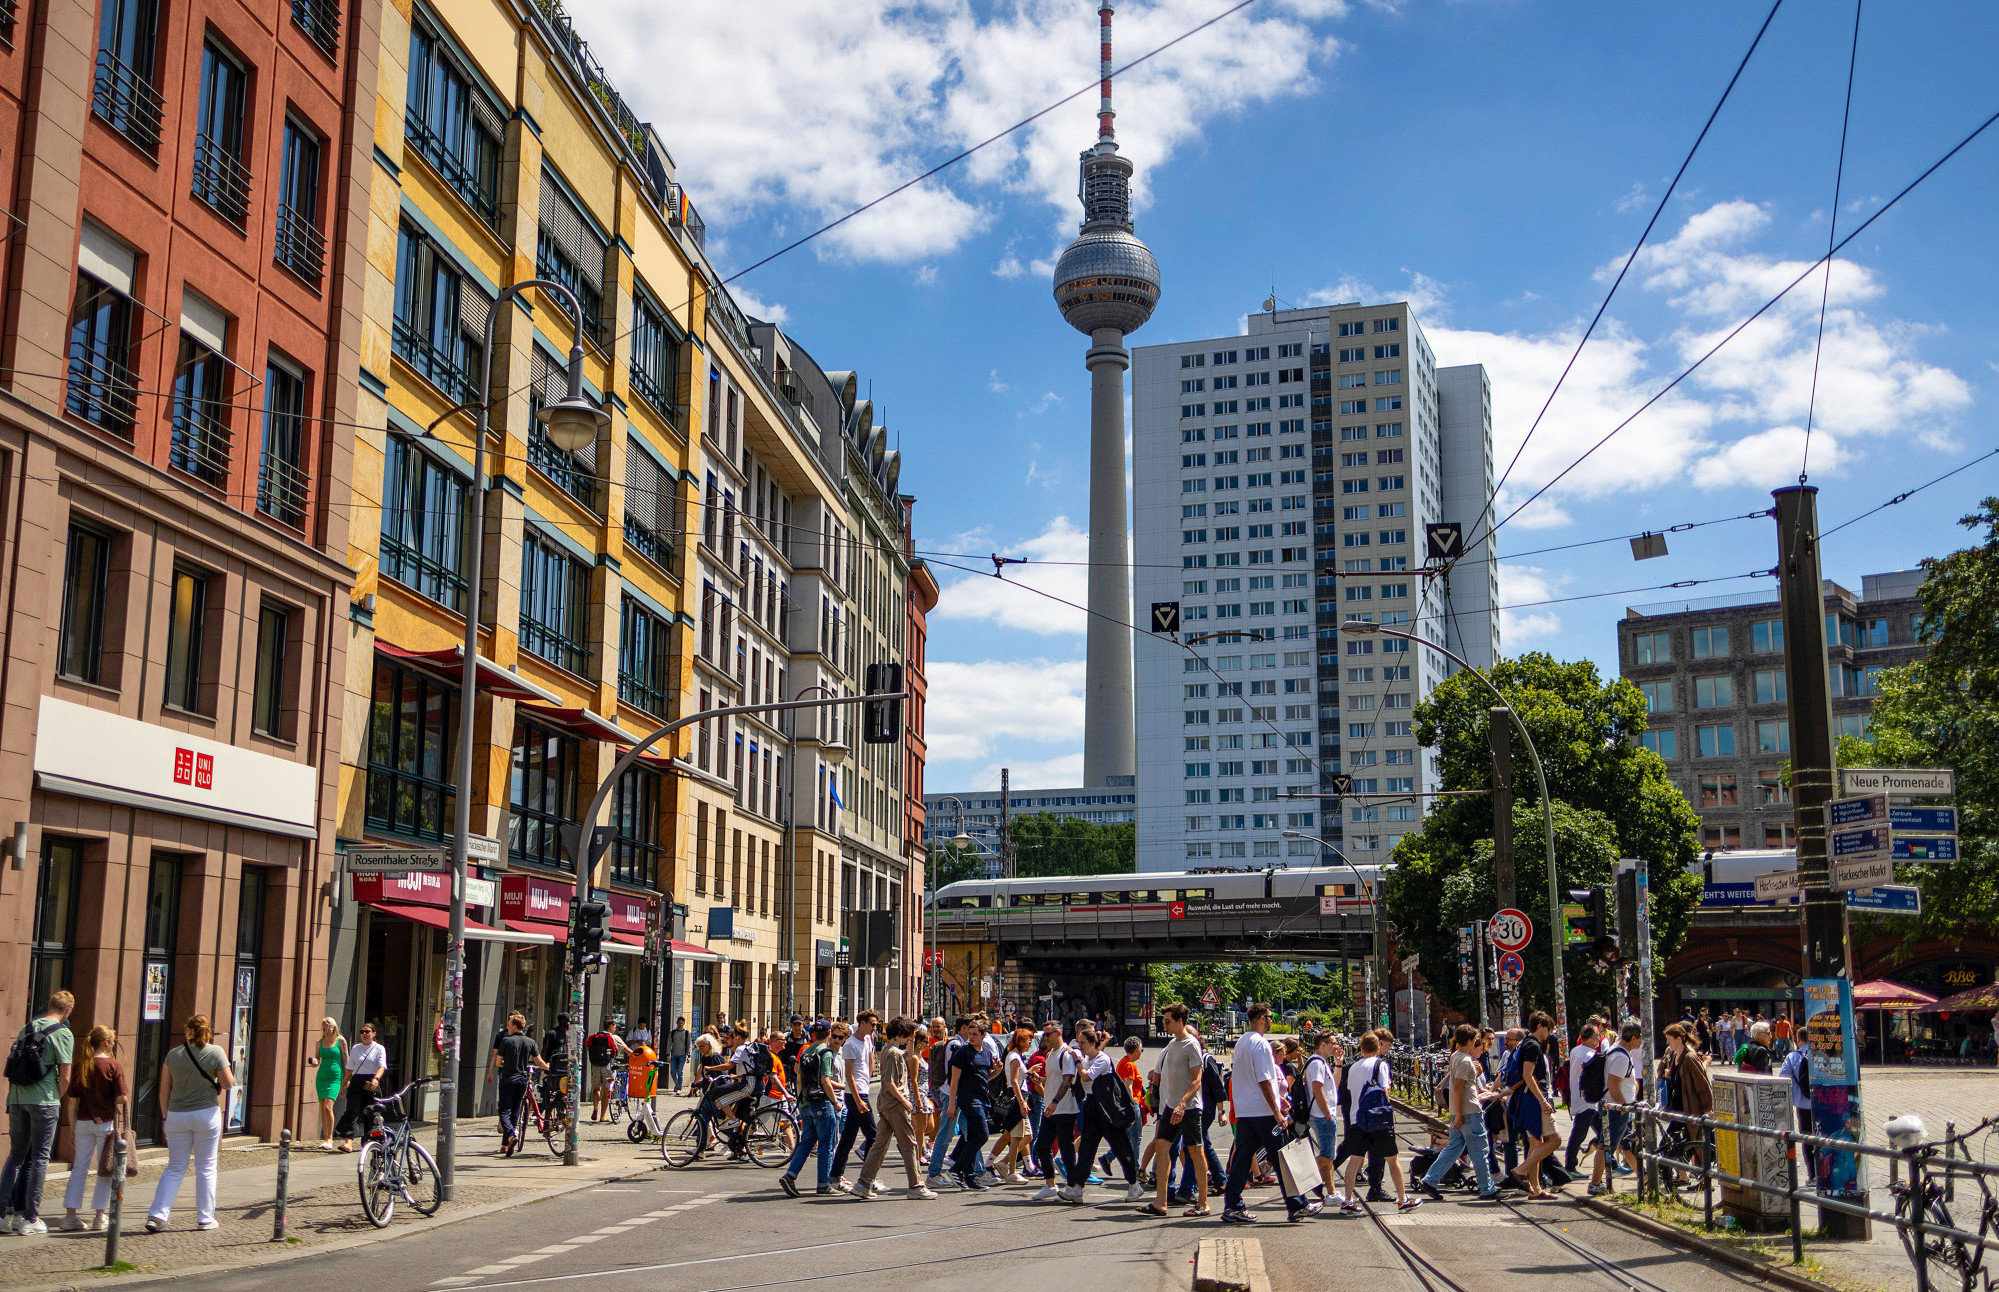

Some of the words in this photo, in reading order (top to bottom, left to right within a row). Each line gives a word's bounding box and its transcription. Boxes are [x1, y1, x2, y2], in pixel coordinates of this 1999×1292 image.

[178, 753, 190, 766] ユニ
[198, 758, 210, 772] UNI
[177, 767, 190, 780] クロ
[198, 772, 210, 785] QLO
[1850, 774, 1878, 787] Neue
[1882, 775, 1944, 788] Promenade
[355, 854, 409, 865] Rosenthaler
[410, 854, 439, 868] Straße
[1838, 868, 1868, 881] Hackescher
[1869, 864, 1886, 878] Markt
[504, 892, 522, 900] MUJI
[531, 887, 548, 910] MUJI
[1700, 890, 1725, 899] GEHT'S
[1727, 890, 1756, 899] WEITER
[627, 904, 640, 923] MUJI
[1500, 920, 1522, 939] 30
[1944, 970, 1976, 983] BBQ
